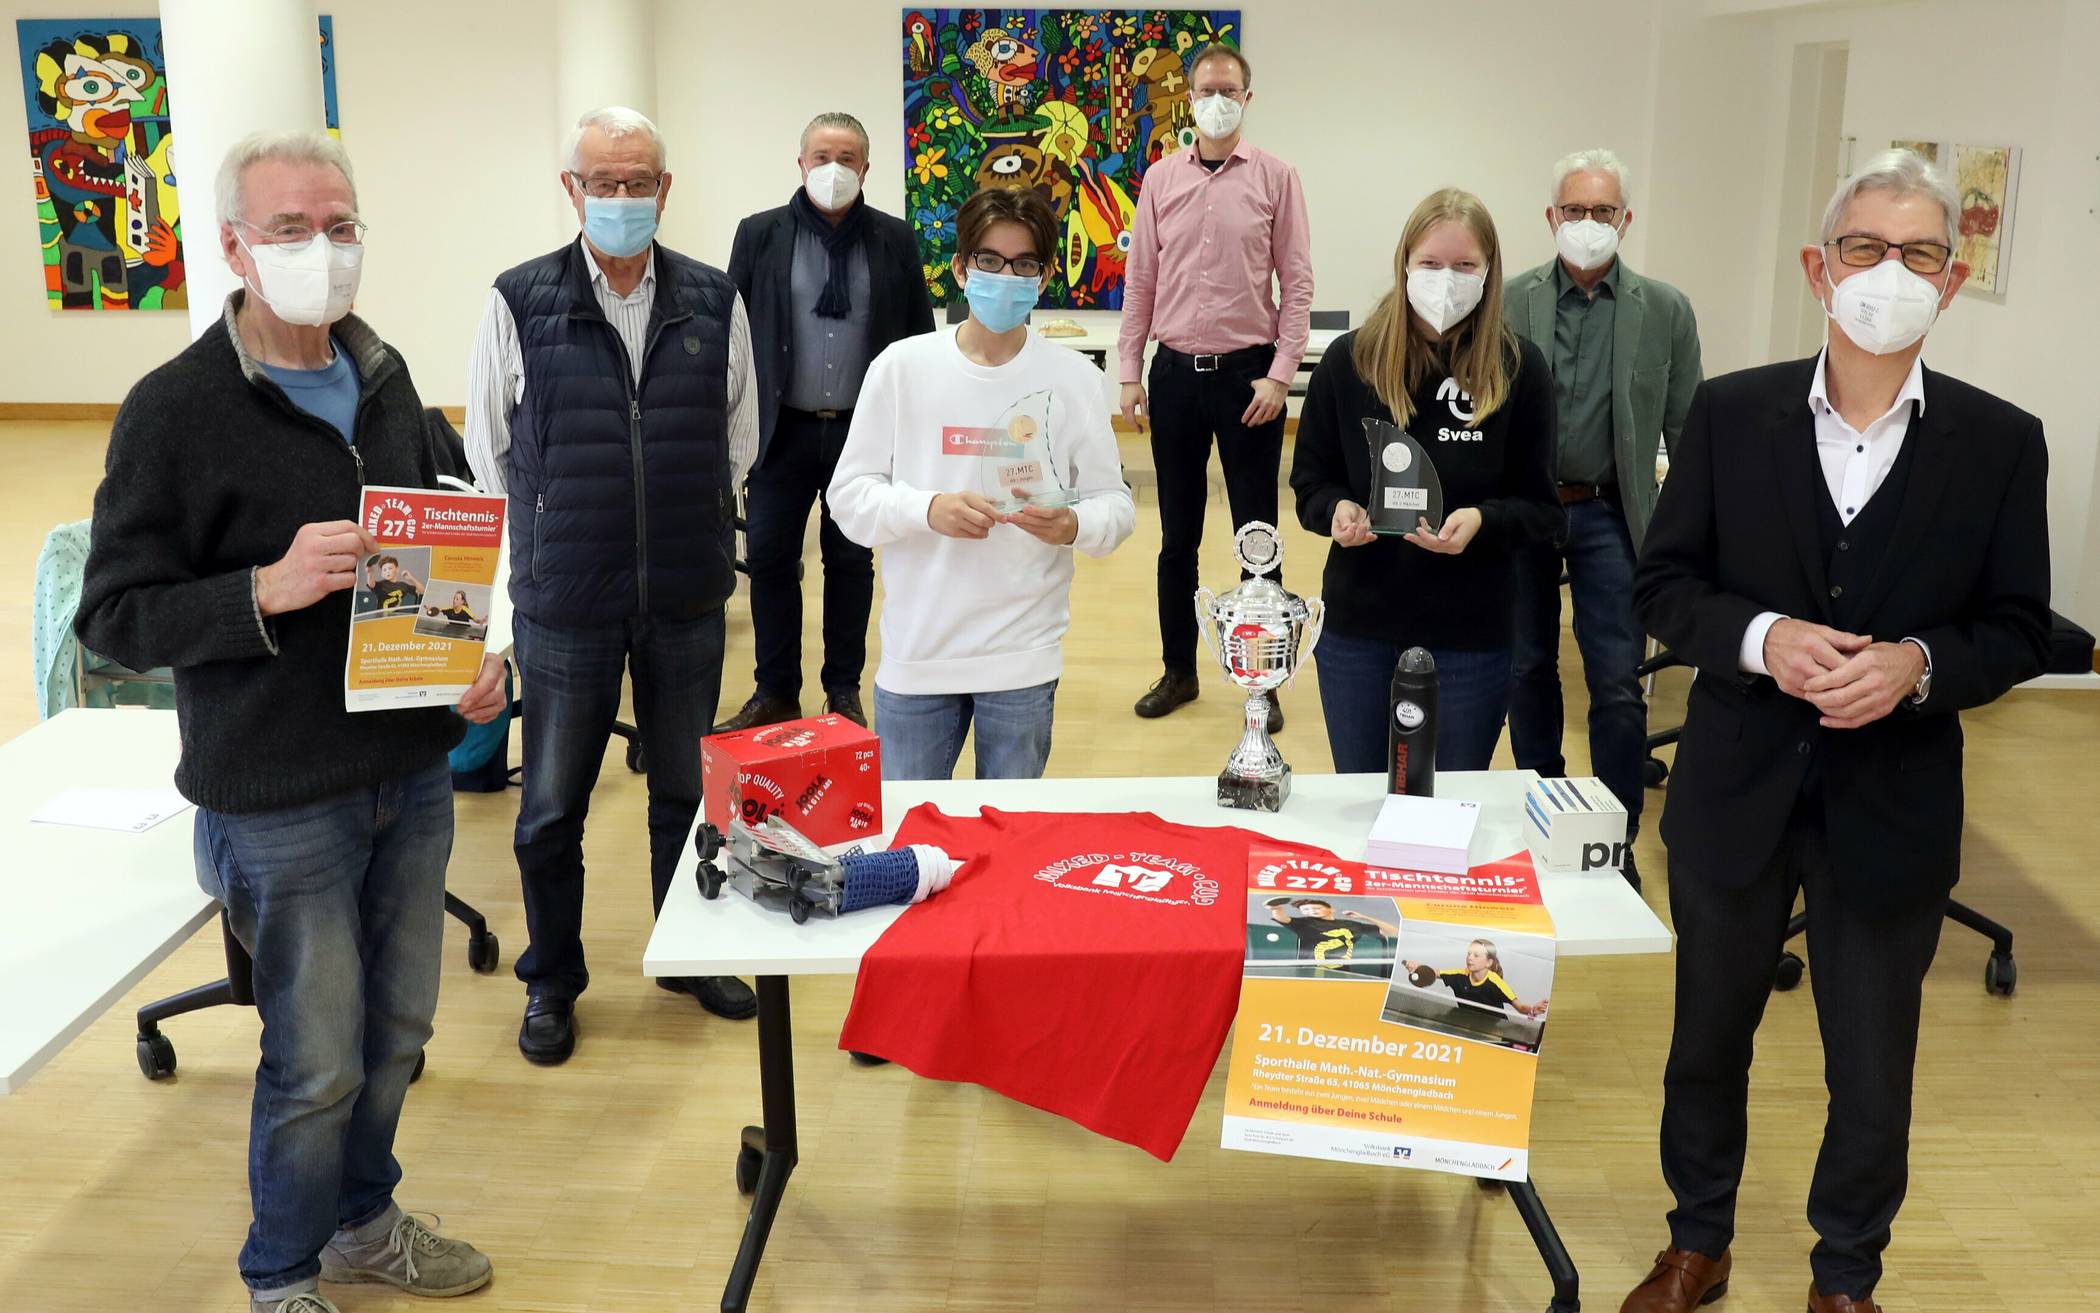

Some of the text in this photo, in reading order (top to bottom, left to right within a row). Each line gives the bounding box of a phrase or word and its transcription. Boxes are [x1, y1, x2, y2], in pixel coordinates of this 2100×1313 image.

[1438, 428, 1483, 441] Svea
[385, 498, 412, 516] TEAM
[406, 519, 417, 539] CUP
[424, 507, 499, 523] Tischtennis-
[382, 520, 404, 537] 27
[362, 641, 453, 652] 21. Dezember 2021
[855, 750, 874, 760] 72 pcs
[737, 772, 752, 784] TOP
[753, 774, 785, 800] QUALITY
[802, 790, 824, 817] MAGIC
[1129, 852, 1200, 876] TEAM
[1190, 879, 1219, 906] CUP
[1285, 860, 1341, 876] TEAM
[1364, 870, 1525, 887] Tischtennis-
[1285, 876, 1329, 889] 27
[1258, 1023, 1463, 1064] 21. Dezember 2021
[1255, 1054, 1456, 1087] Sporthalle Math.-Nat.-Gymnasium
[1252, 1068, 1294, 1081] Rheydter
[1296, 1073, 1325, 1086] Straße
[1342, 1080, 1370, 1090] 41065
[1372, 1082, 1454, 1100] Mönchengladbach
[1249, 1097, 1403, 1124] Anmeldung über Deine Schule
